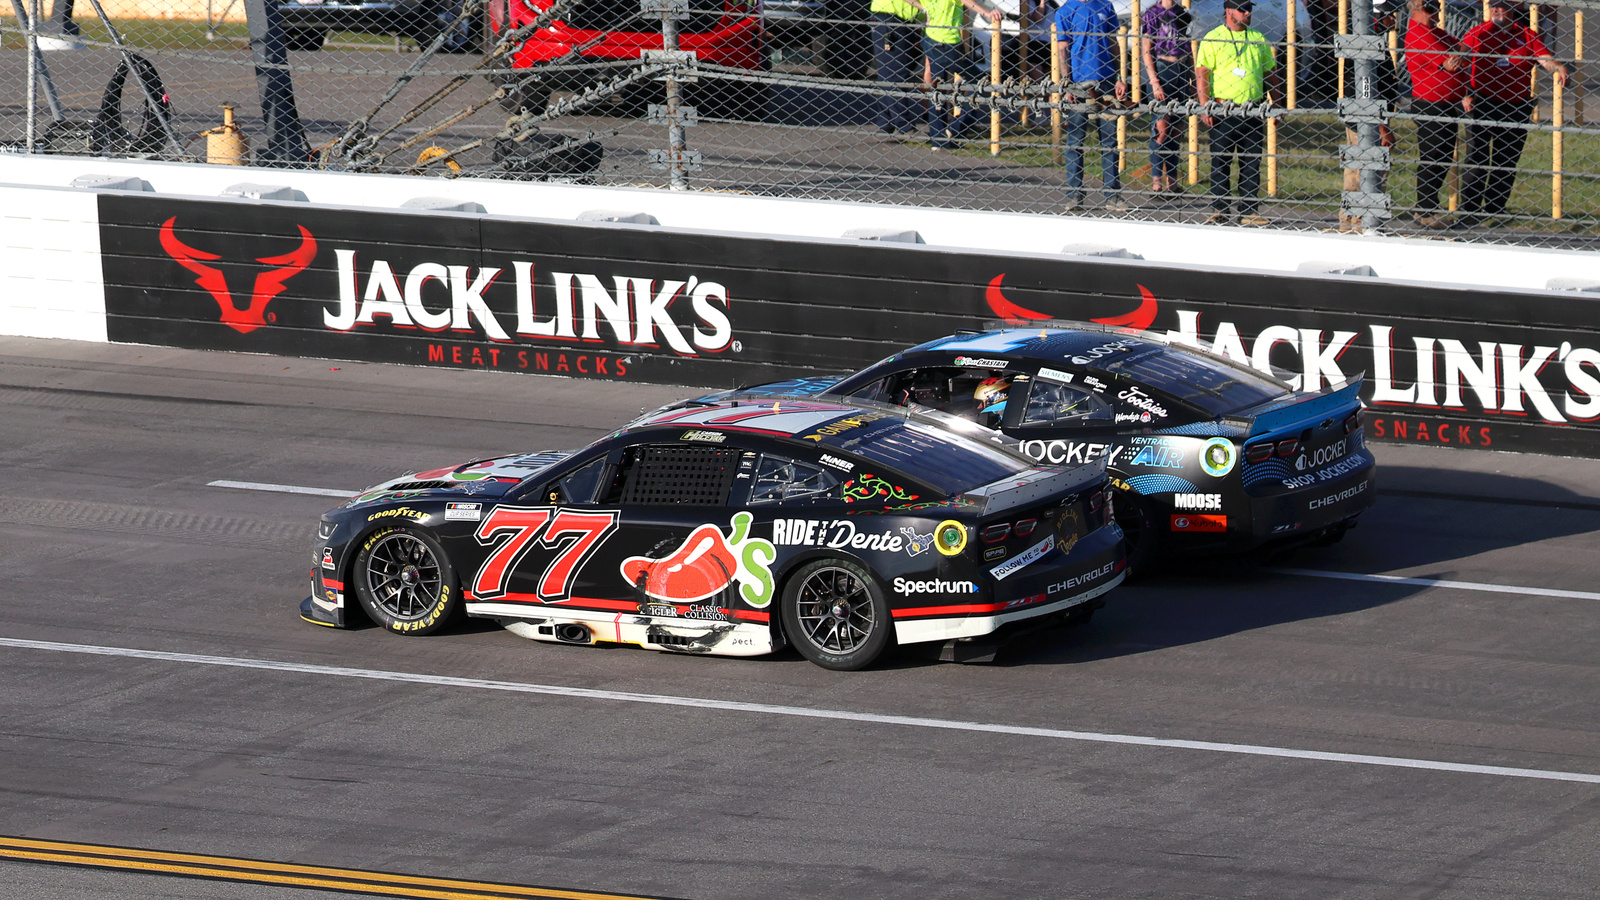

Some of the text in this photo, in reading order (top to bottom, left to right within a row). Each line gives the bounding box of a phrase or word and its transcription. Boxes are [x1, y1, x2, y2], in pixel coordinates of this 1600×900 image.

[322, 249, 733, 356] JACK LINK'S
[428, 344, 627, 376] MEAT SNACKS
[1040, 369, 1073, 381] SIEMENS
[1369, 324, 1600, 425] LINK'S
[1117, 386, 1169, 418] Tootsies
[1115, 411, 1141, 424] Wendy's
[1374, 419, 1492, 446] SNACKS
[1130, 445, 1184, 468] AIR
[1308, 438, 1347, 468] JOCKEY
[1282, 453, 1367, 489] SHOP JOCKEY.COM
[1174, 493, 1222, 508] MOOSE
[1309, 480, 1369, 510] CHEVROLET
[367, 506, 431, 522] GOODYEAR
[364, 525, 394, 551] EAGLE
[773, 518, 820, 546] RIDE
[818, 521, 829, 546] THE
[472, 504, 621, 604] 77
[994, 557, 1023, 577] FOLLOW
[1022, 553, 1034, 565] ME
[893, 577, 974, 597] Spectrum
[1047, 561, 1115, 594] CHEVROLET
[392, 585, 450, 632] GOODYEAR
[640, 606, 678, 618] IGLER
[684, 611, 728, 621] COLLISION
[689, 604, 723, 614] CLASSIC
